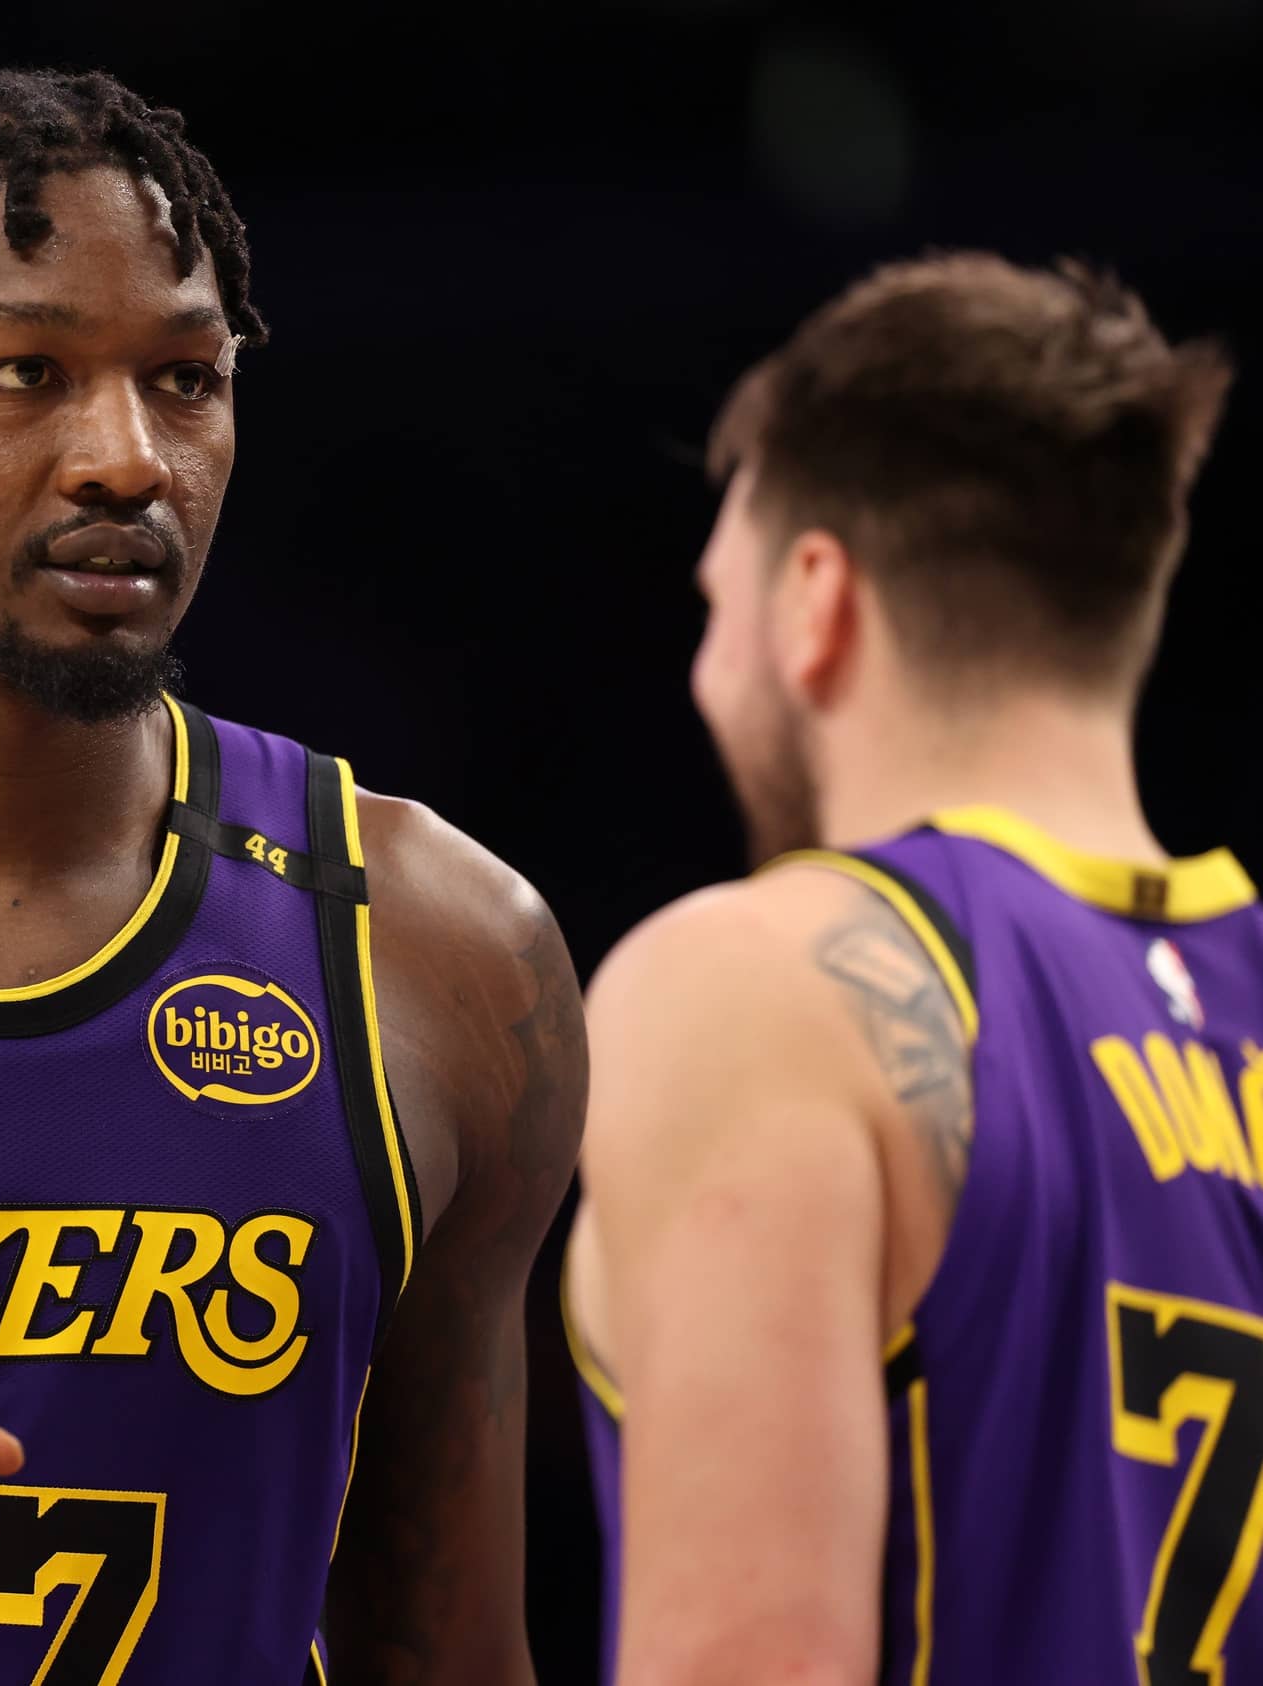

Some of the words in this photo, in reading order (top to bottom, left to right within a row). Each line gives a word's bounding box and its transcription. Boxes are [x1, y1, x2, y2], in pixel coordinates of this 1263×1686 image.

[244, 833, 289, 876] 44
[164, 1006, 310, 1069] bibigo
[191, 1051, 253, 1076] 비비고
